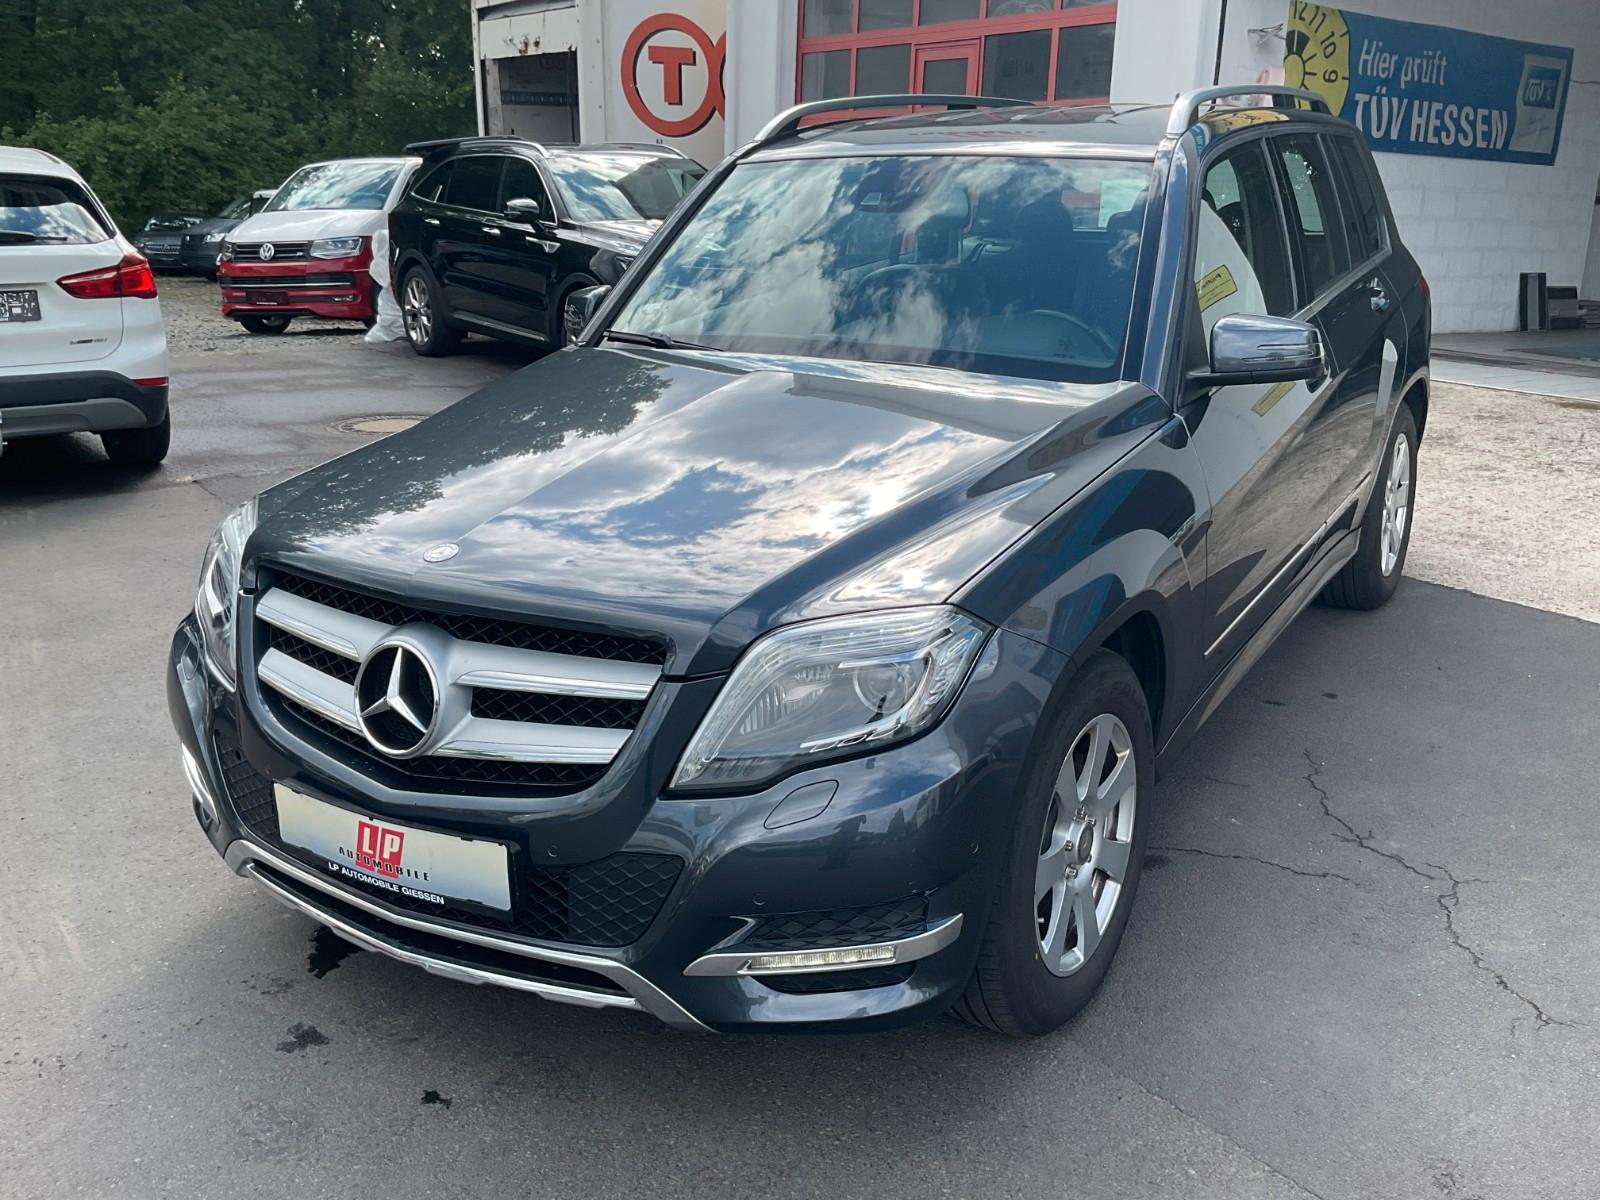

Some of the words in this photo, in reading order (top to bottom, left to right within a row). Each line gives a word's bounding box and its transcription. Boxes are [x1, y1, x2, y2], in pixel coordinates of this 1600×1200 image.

[1309, 6, 1326, 34] 11
[1320, 31, 1336, 59] 10
[1323, 69, 1338, 83] 9
[1358, 39, 1399, 79] Hier
[1401, 51, 1448, 89] prüft
[1355, 86, 1408, 140] TÜV
[1410, 100, 1508, 150] HESSEN
[363, 826, 400, 859] LP
[338, 846, 430, 881] AUTOMOBILE
[328, 862, 339, 870] LP
[341, 867, 399, 892] AUTOMOBILE
[402, 887, 444, 904] GIESSEN
